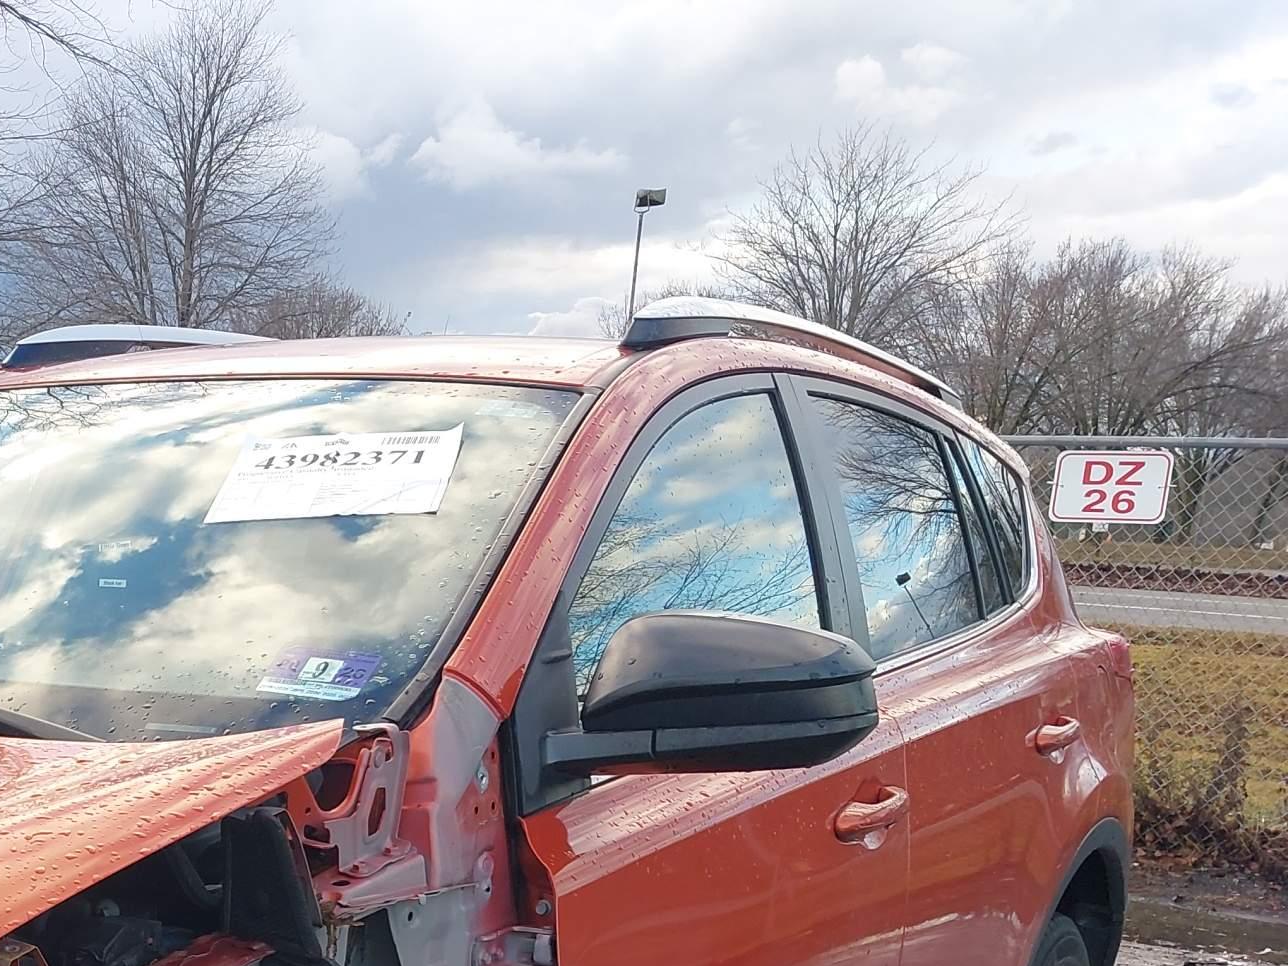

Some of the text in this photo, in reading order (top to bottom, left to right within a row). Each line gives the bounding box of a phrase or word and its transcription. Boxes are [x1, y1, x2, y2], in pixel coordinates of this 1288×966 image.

[254, 449, 426, 471] 43982371
[1081, 460, 1147, 486] DZ
[1080, 488, 1136, 515] 26
